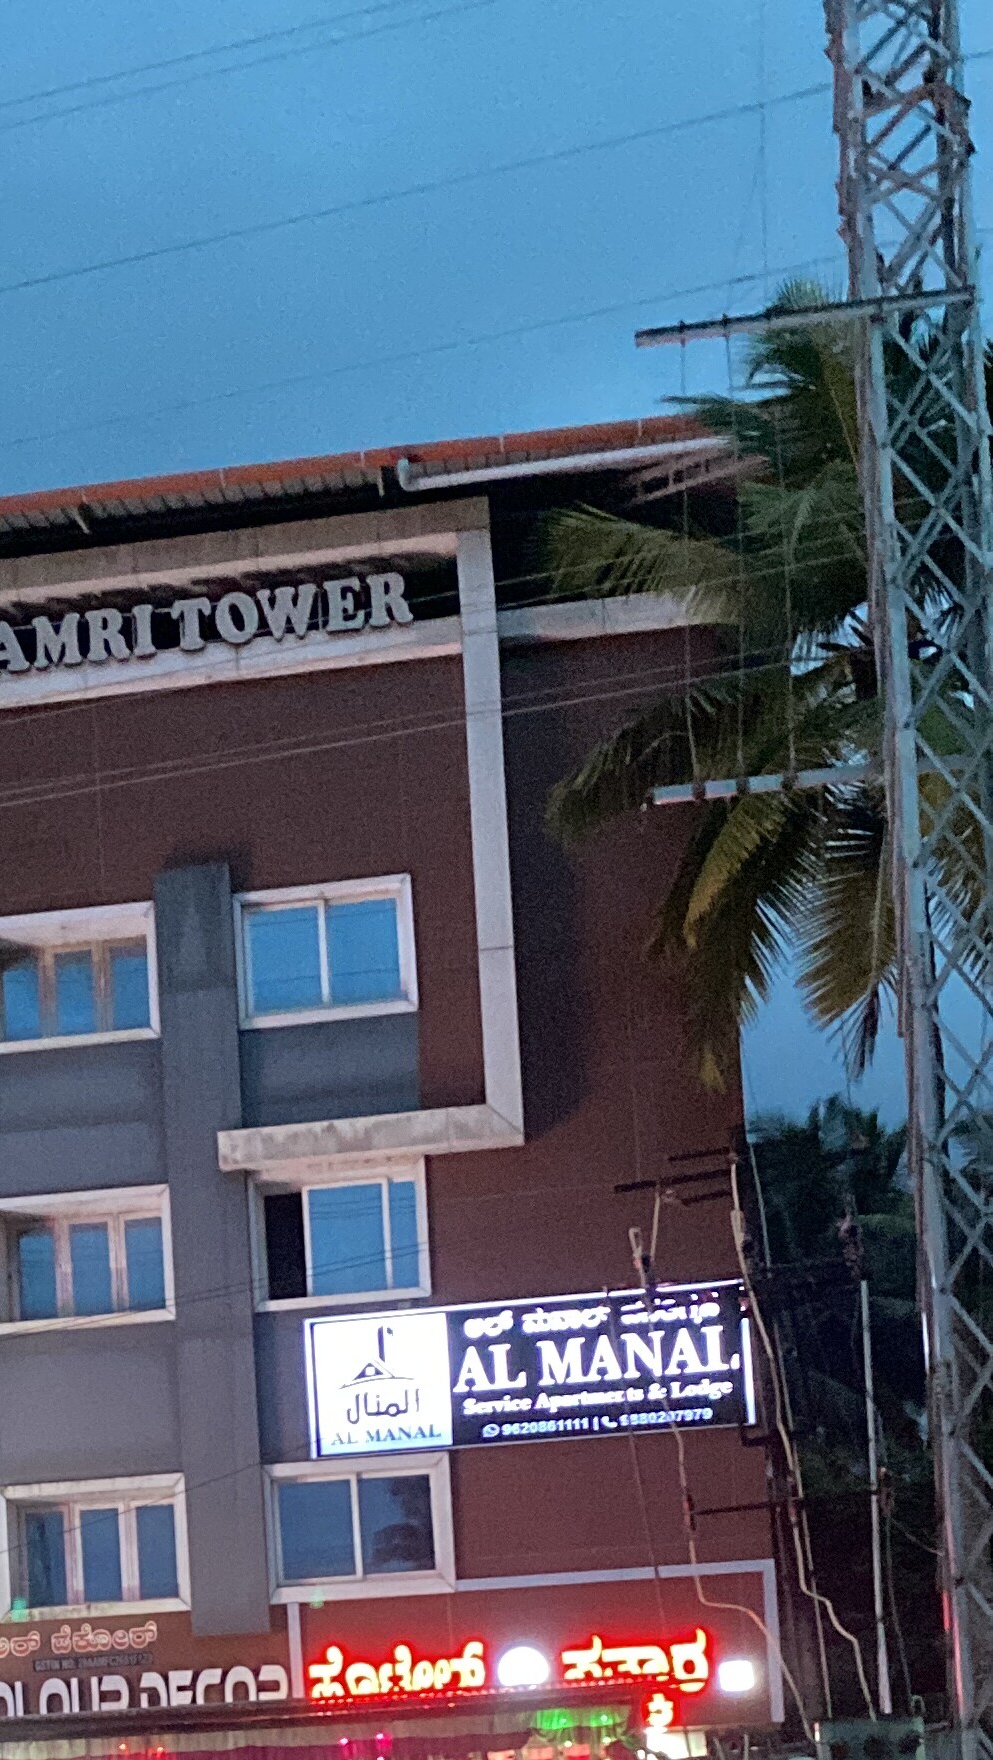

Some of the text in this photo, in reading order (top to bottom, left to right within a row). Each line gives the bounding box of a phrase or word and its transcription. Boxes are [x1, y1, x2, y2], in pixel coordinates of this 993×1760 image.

[171, 572, 412, 652] TOWER
[453, 1325, 740, 1392] AL MANAL
[347, 1388, 420, 1425] المنال
[463, 1395, 532, 1415] Service
[647, 1383, 668, 1400] &
[671, 1378, 734, 1400] Lodge
[331, 1423, 442, 1446] AL MANAL
